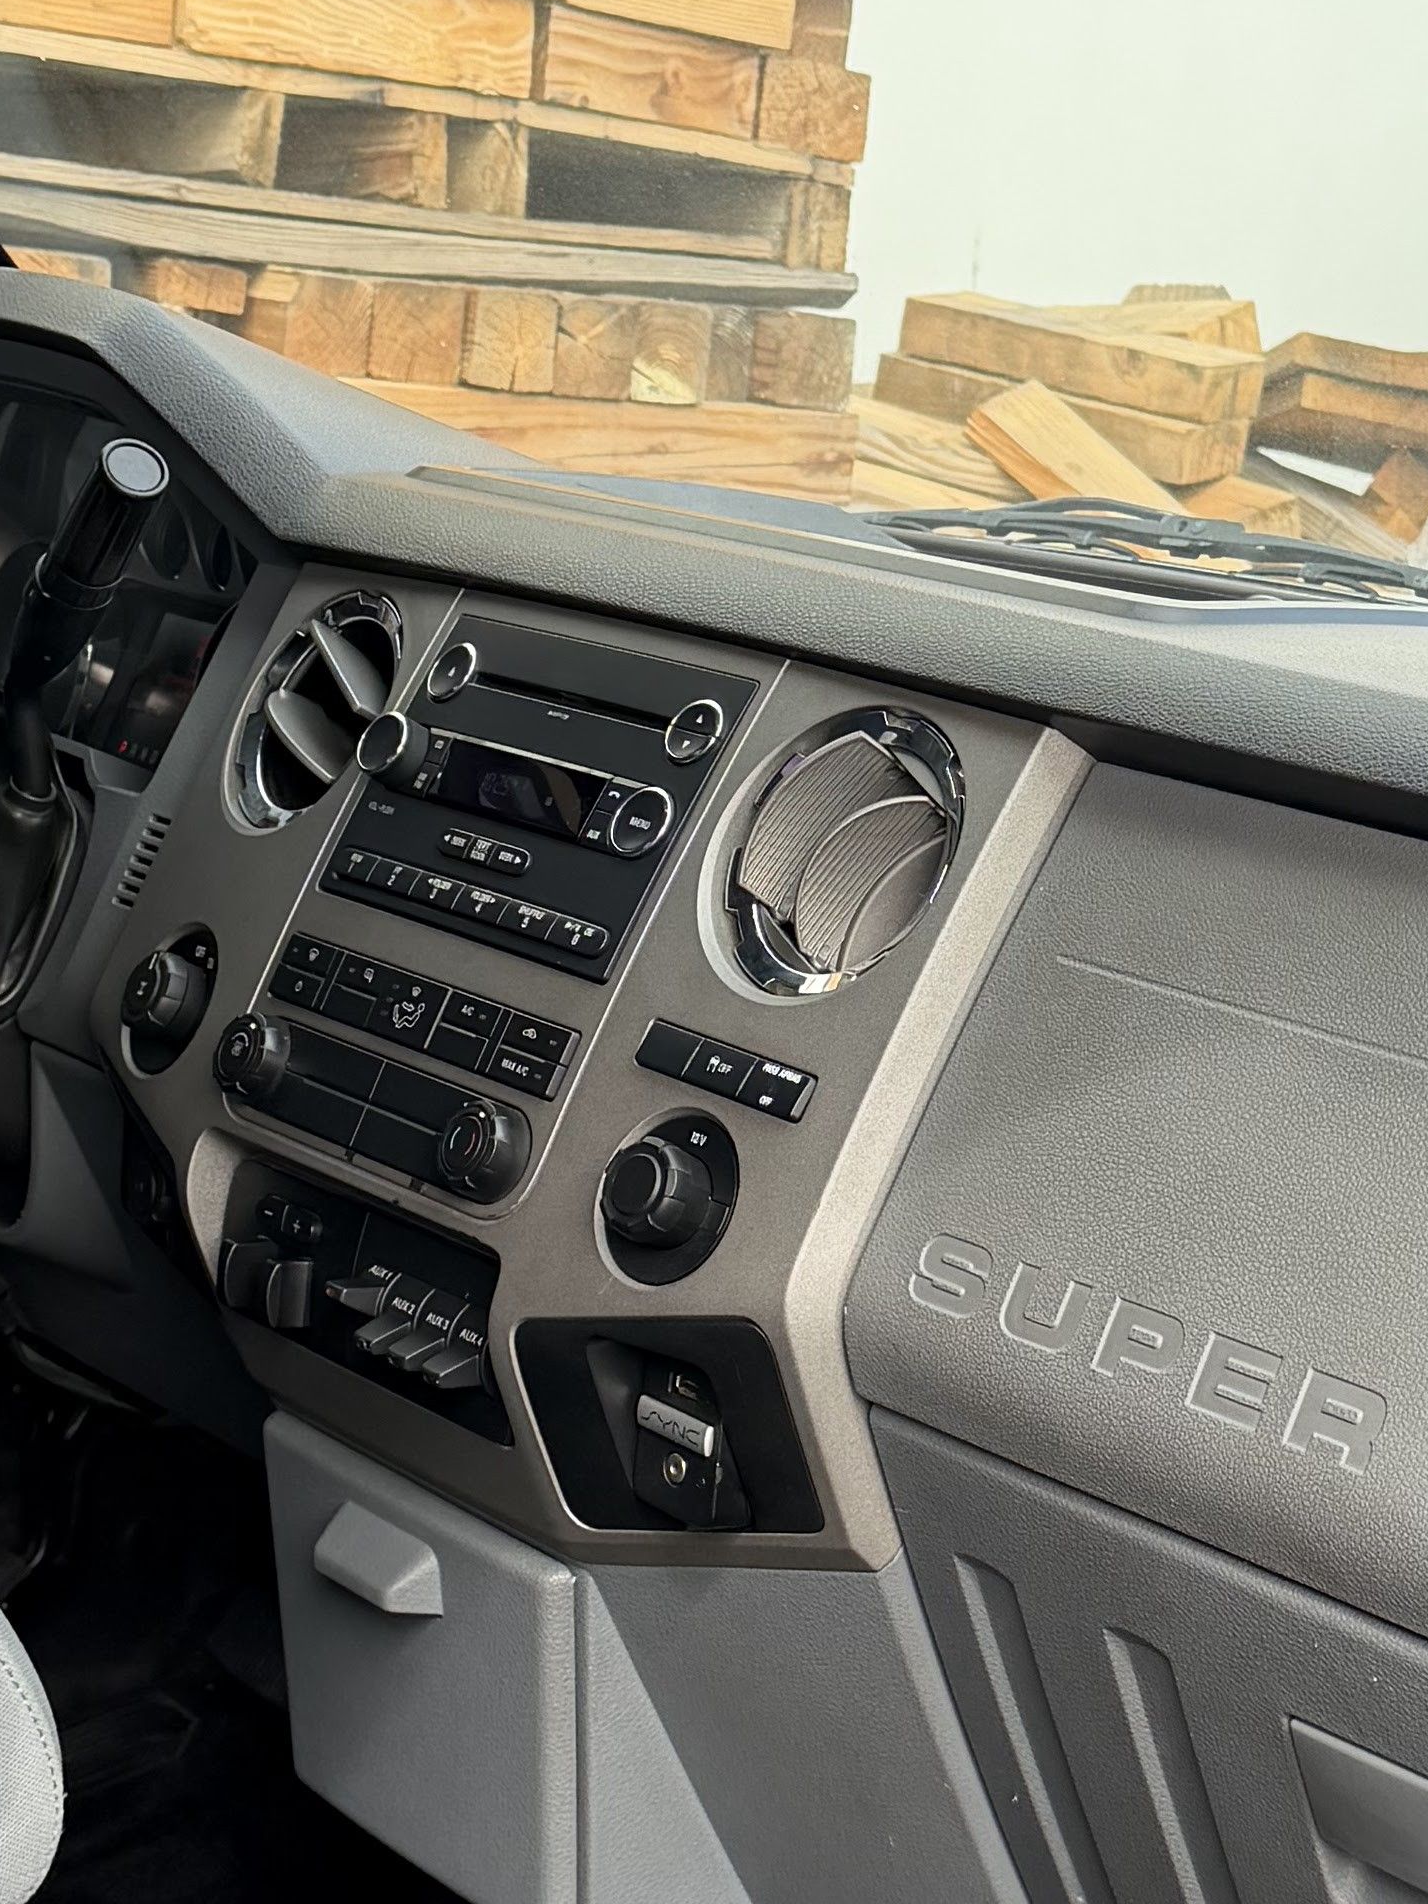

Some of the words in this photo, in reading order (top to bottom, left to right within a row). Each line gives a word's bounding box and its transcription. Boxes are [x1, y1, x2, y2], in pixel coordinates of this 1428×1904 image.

[369, 1264, 386, 1278] AUX
[392, 1296, 408, 1312] AUX
[426, 1311, 442, 1327] AUX
[460, 1328, 477, 1343] AUX
[908, 1230, 1389, 1474] SUPER
[641, 1410, 701, 1448] SYNC
